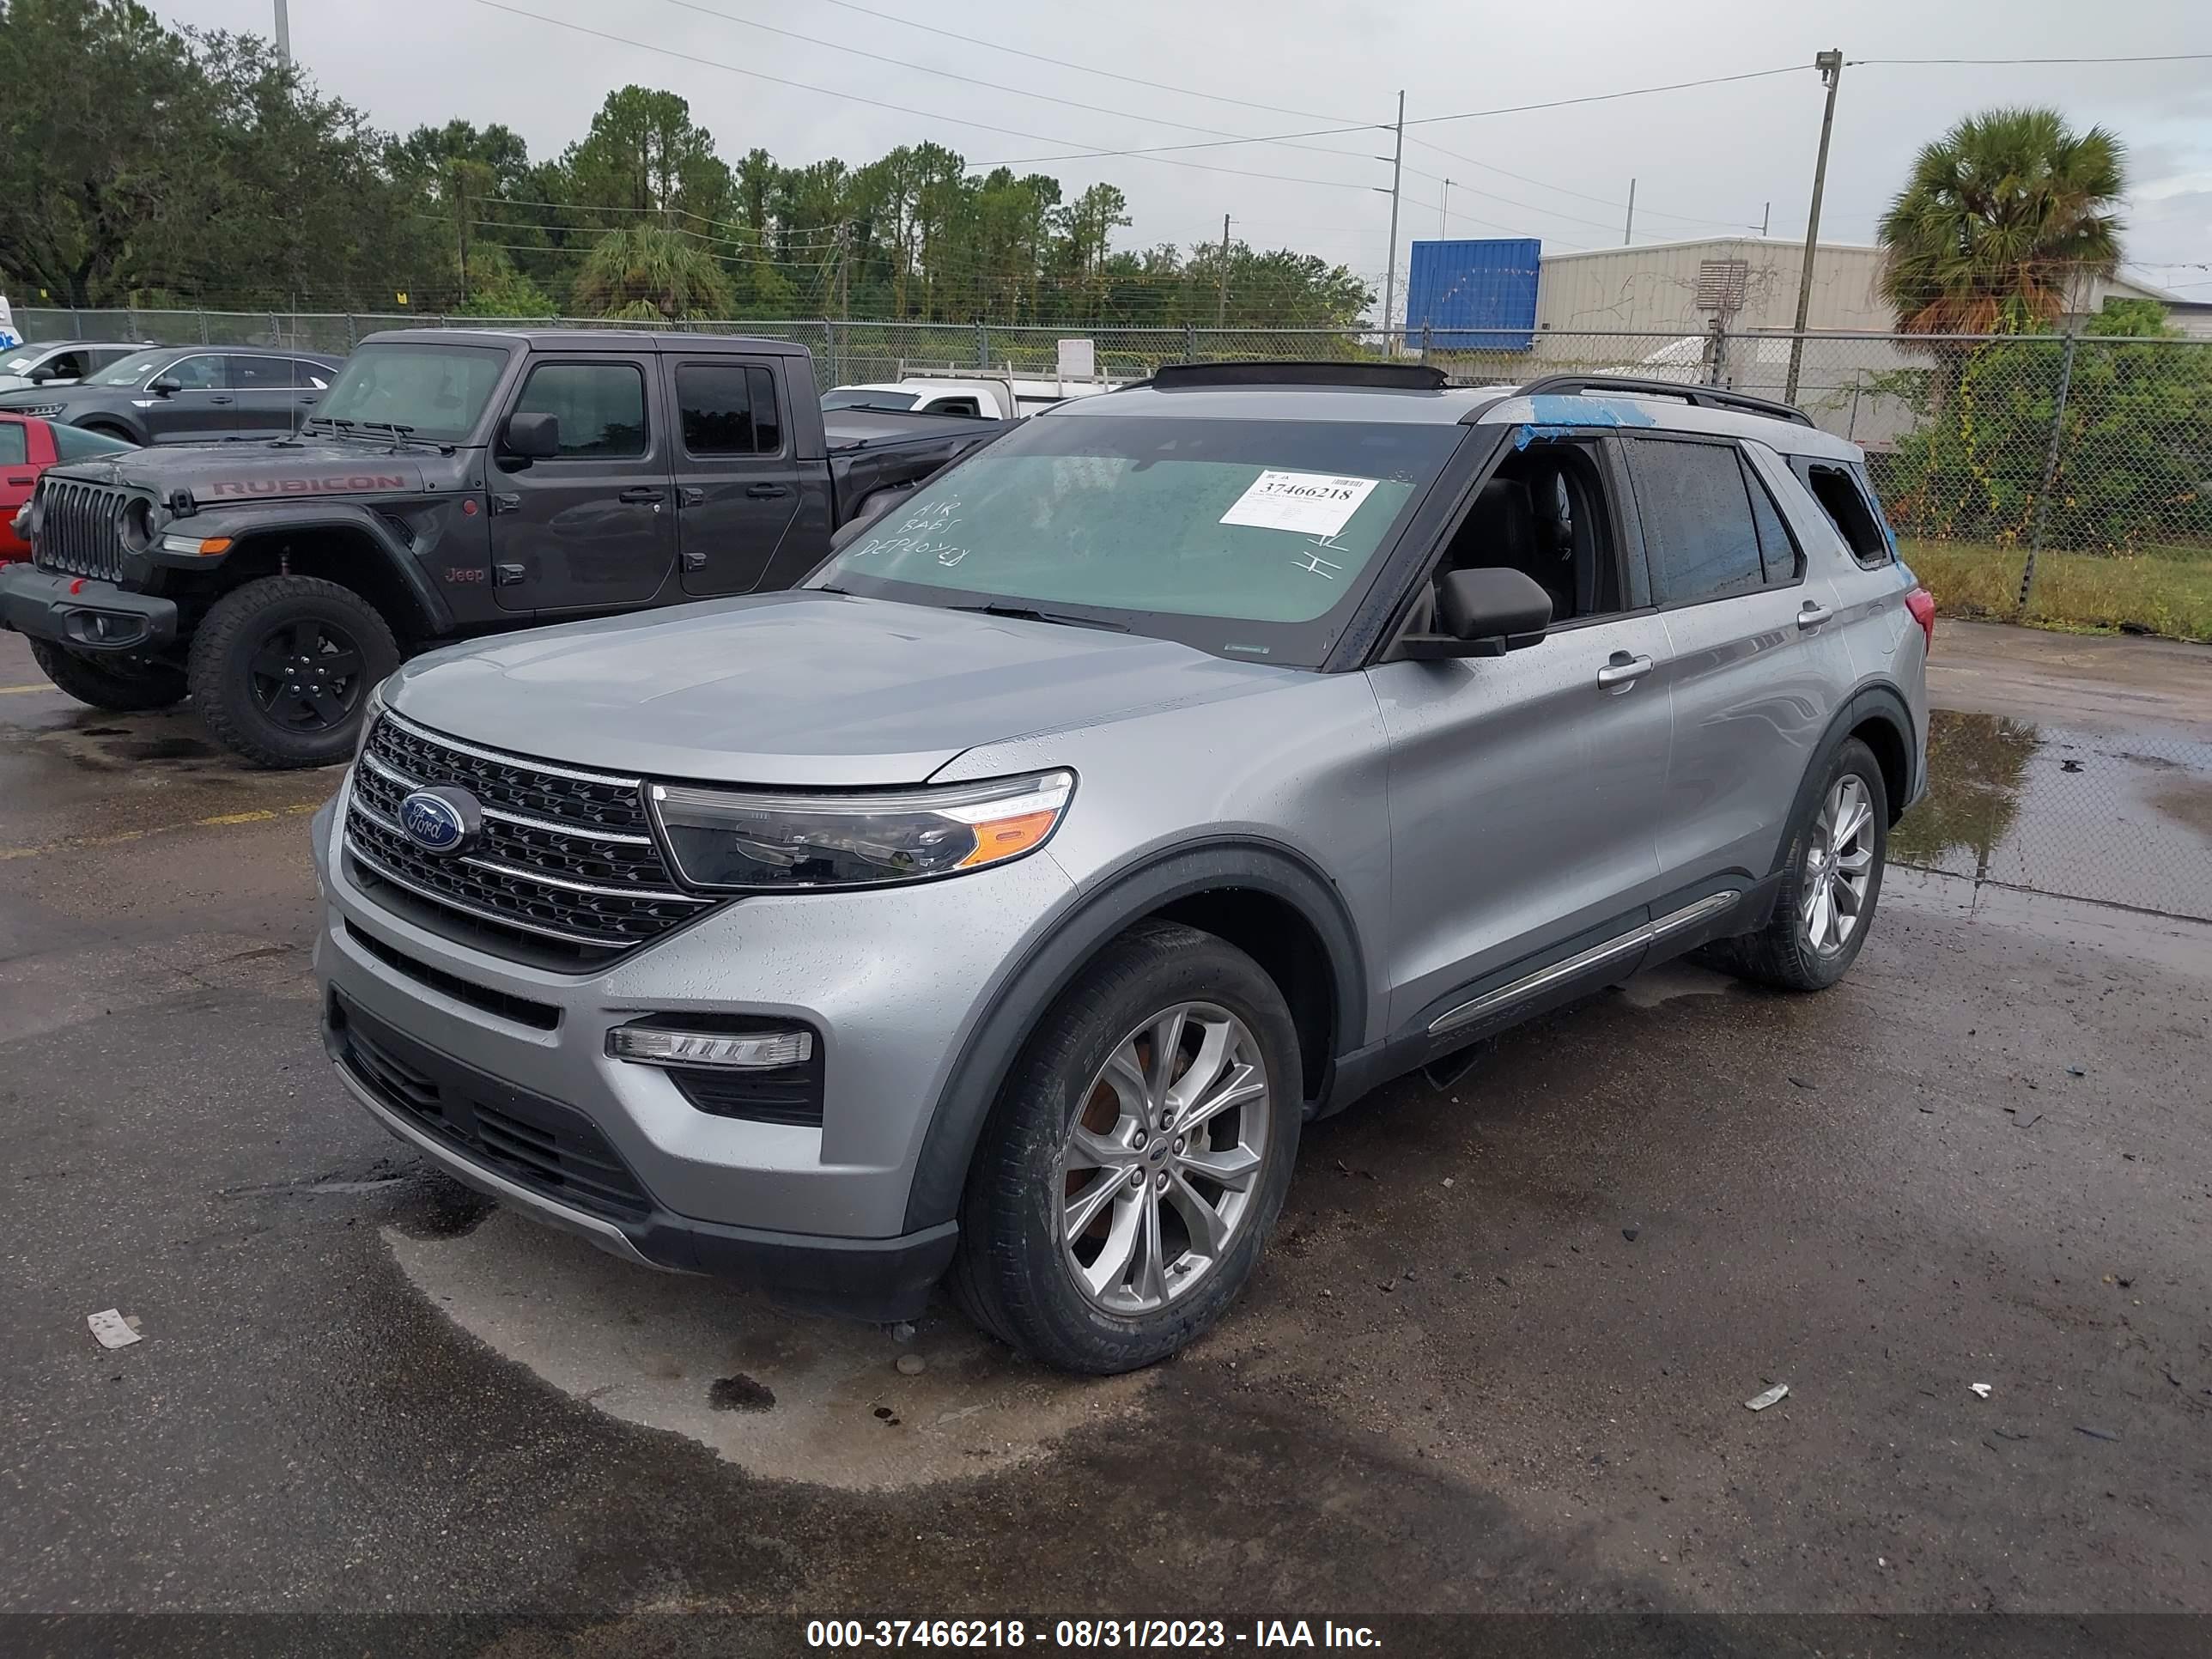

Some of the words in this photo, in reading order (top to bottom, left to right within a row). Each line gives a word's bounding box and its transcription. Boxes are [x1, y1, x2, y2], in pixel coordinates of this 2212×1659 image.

[212, 476, 405, 495] RUBICON
[1259, 483, 1354, 501] 37466218
[913, 501, 962, 517] AIR
[444, 568, 484, 583] Jeep
[408, 803, 444, 839] Ford
